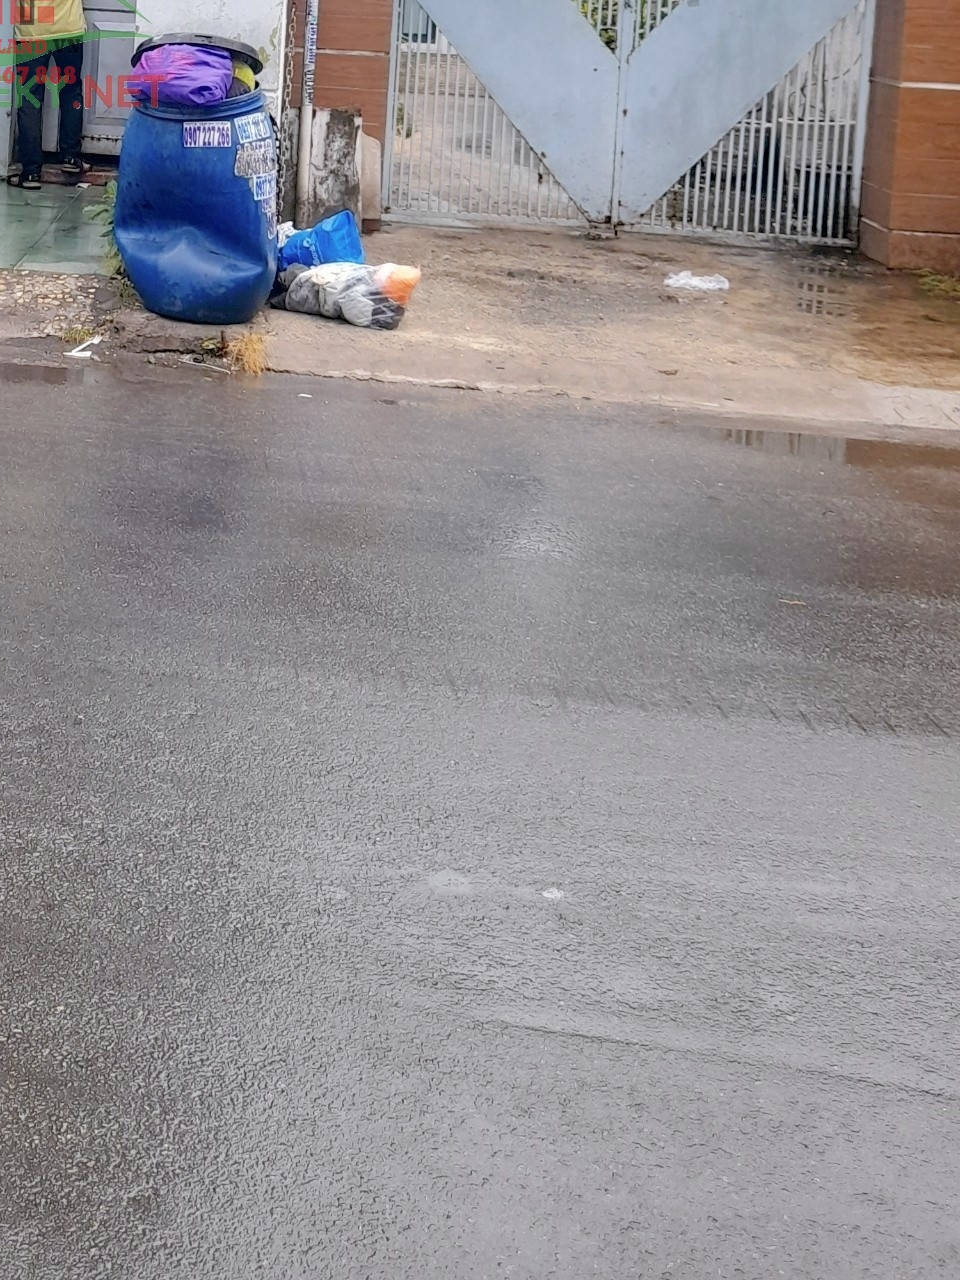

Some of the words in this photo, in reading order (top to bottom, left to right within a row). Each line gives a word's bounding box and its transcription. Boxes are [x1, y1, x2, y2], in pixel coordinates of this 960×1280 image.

[184, 126, 201, 146] 0907
[202, 126, 216, 146] 227
[217, 125, 230, 146] 266
